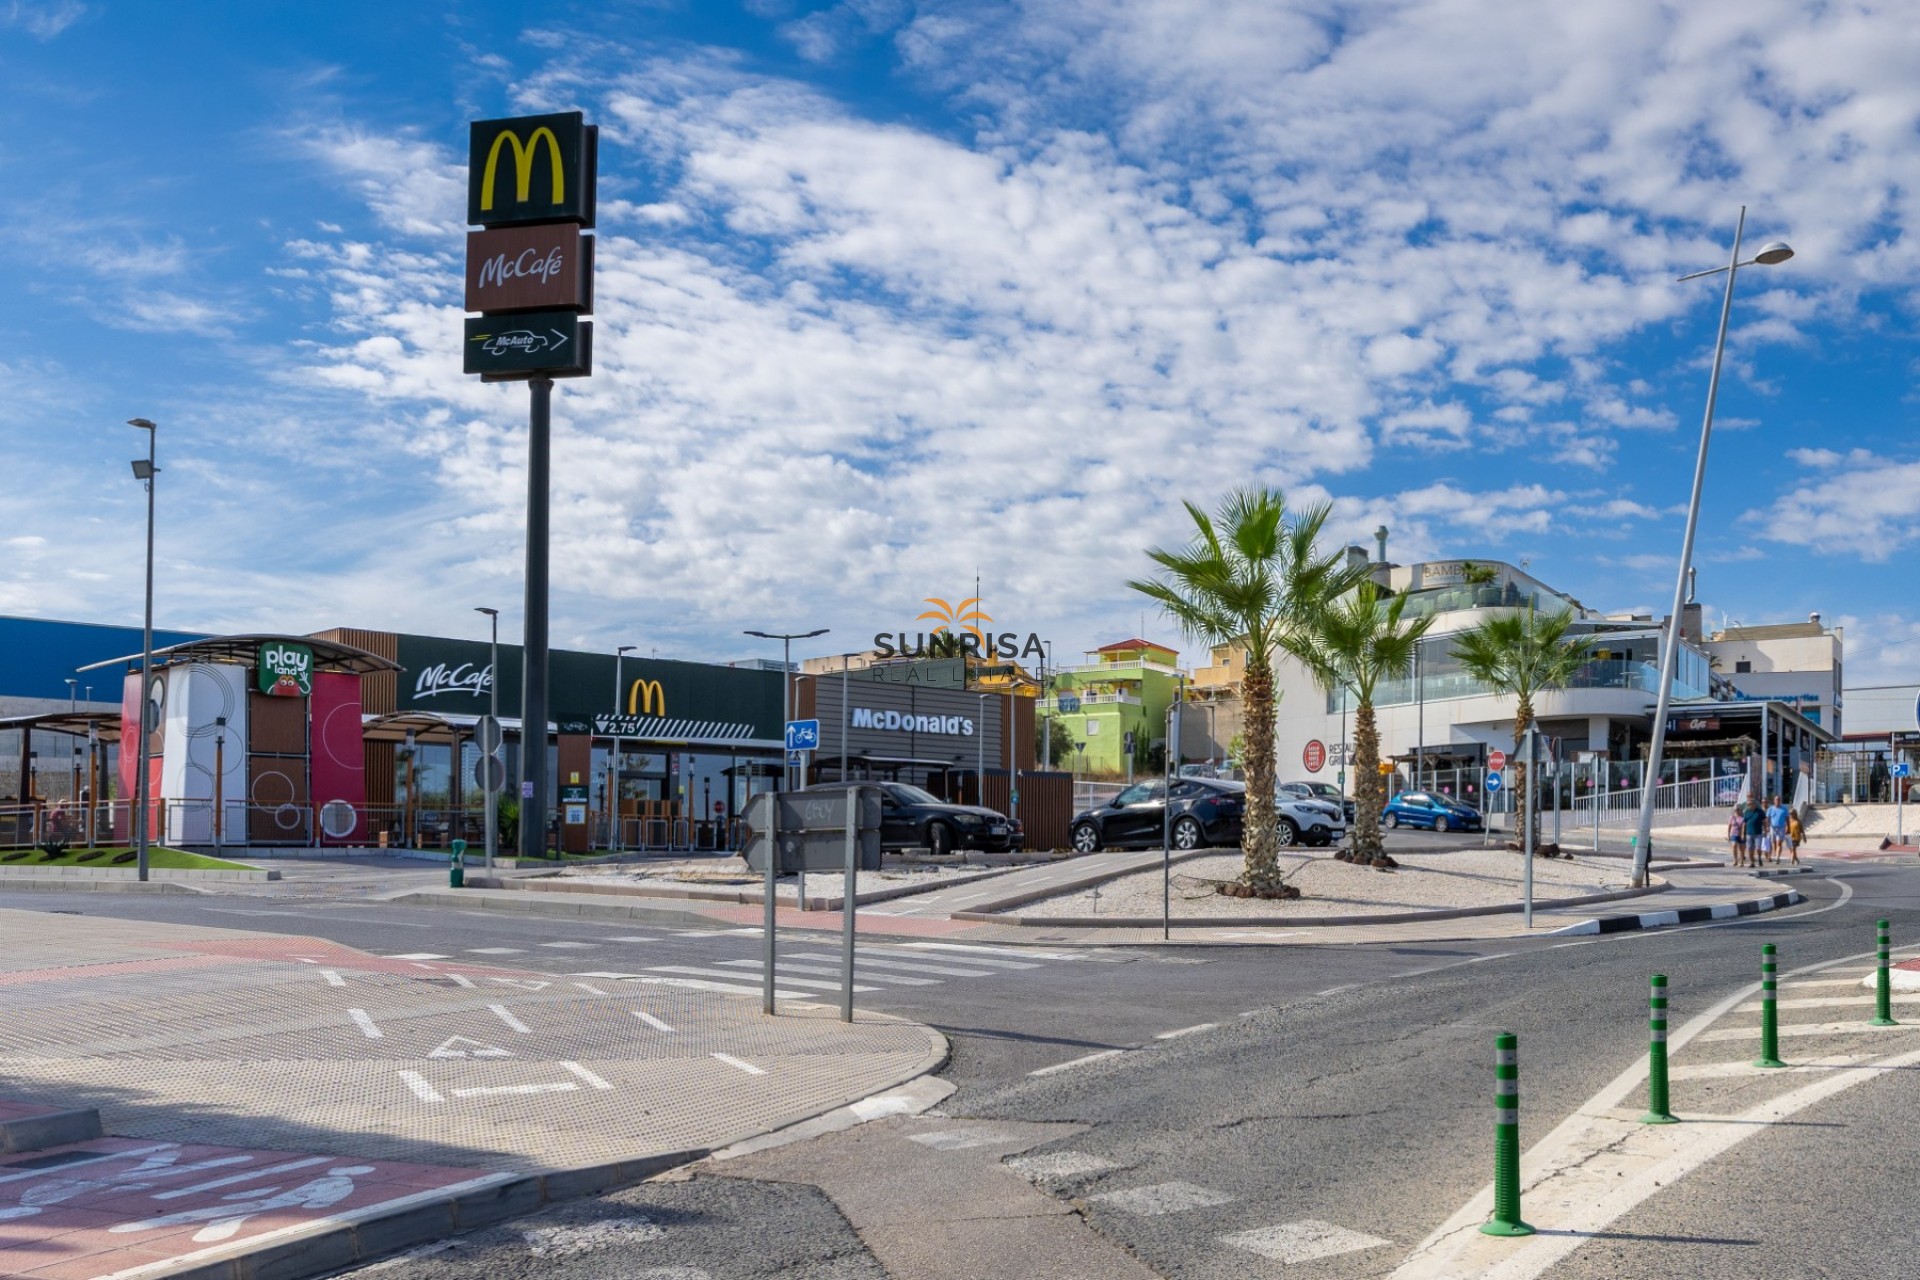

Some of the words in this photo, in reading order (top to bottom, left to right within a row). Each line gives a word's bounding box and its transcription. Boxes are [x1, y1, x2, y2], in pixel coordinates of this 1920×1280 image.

[478, 246, 563, 289] McCafé
[496, 336, 534, 346] McAuto
[265, 645, 309, 672] play
[274, 664, 298, 676] land
[608, 722, 635, 734] 2.75
[851, 707, 974, 736] McDonald's
